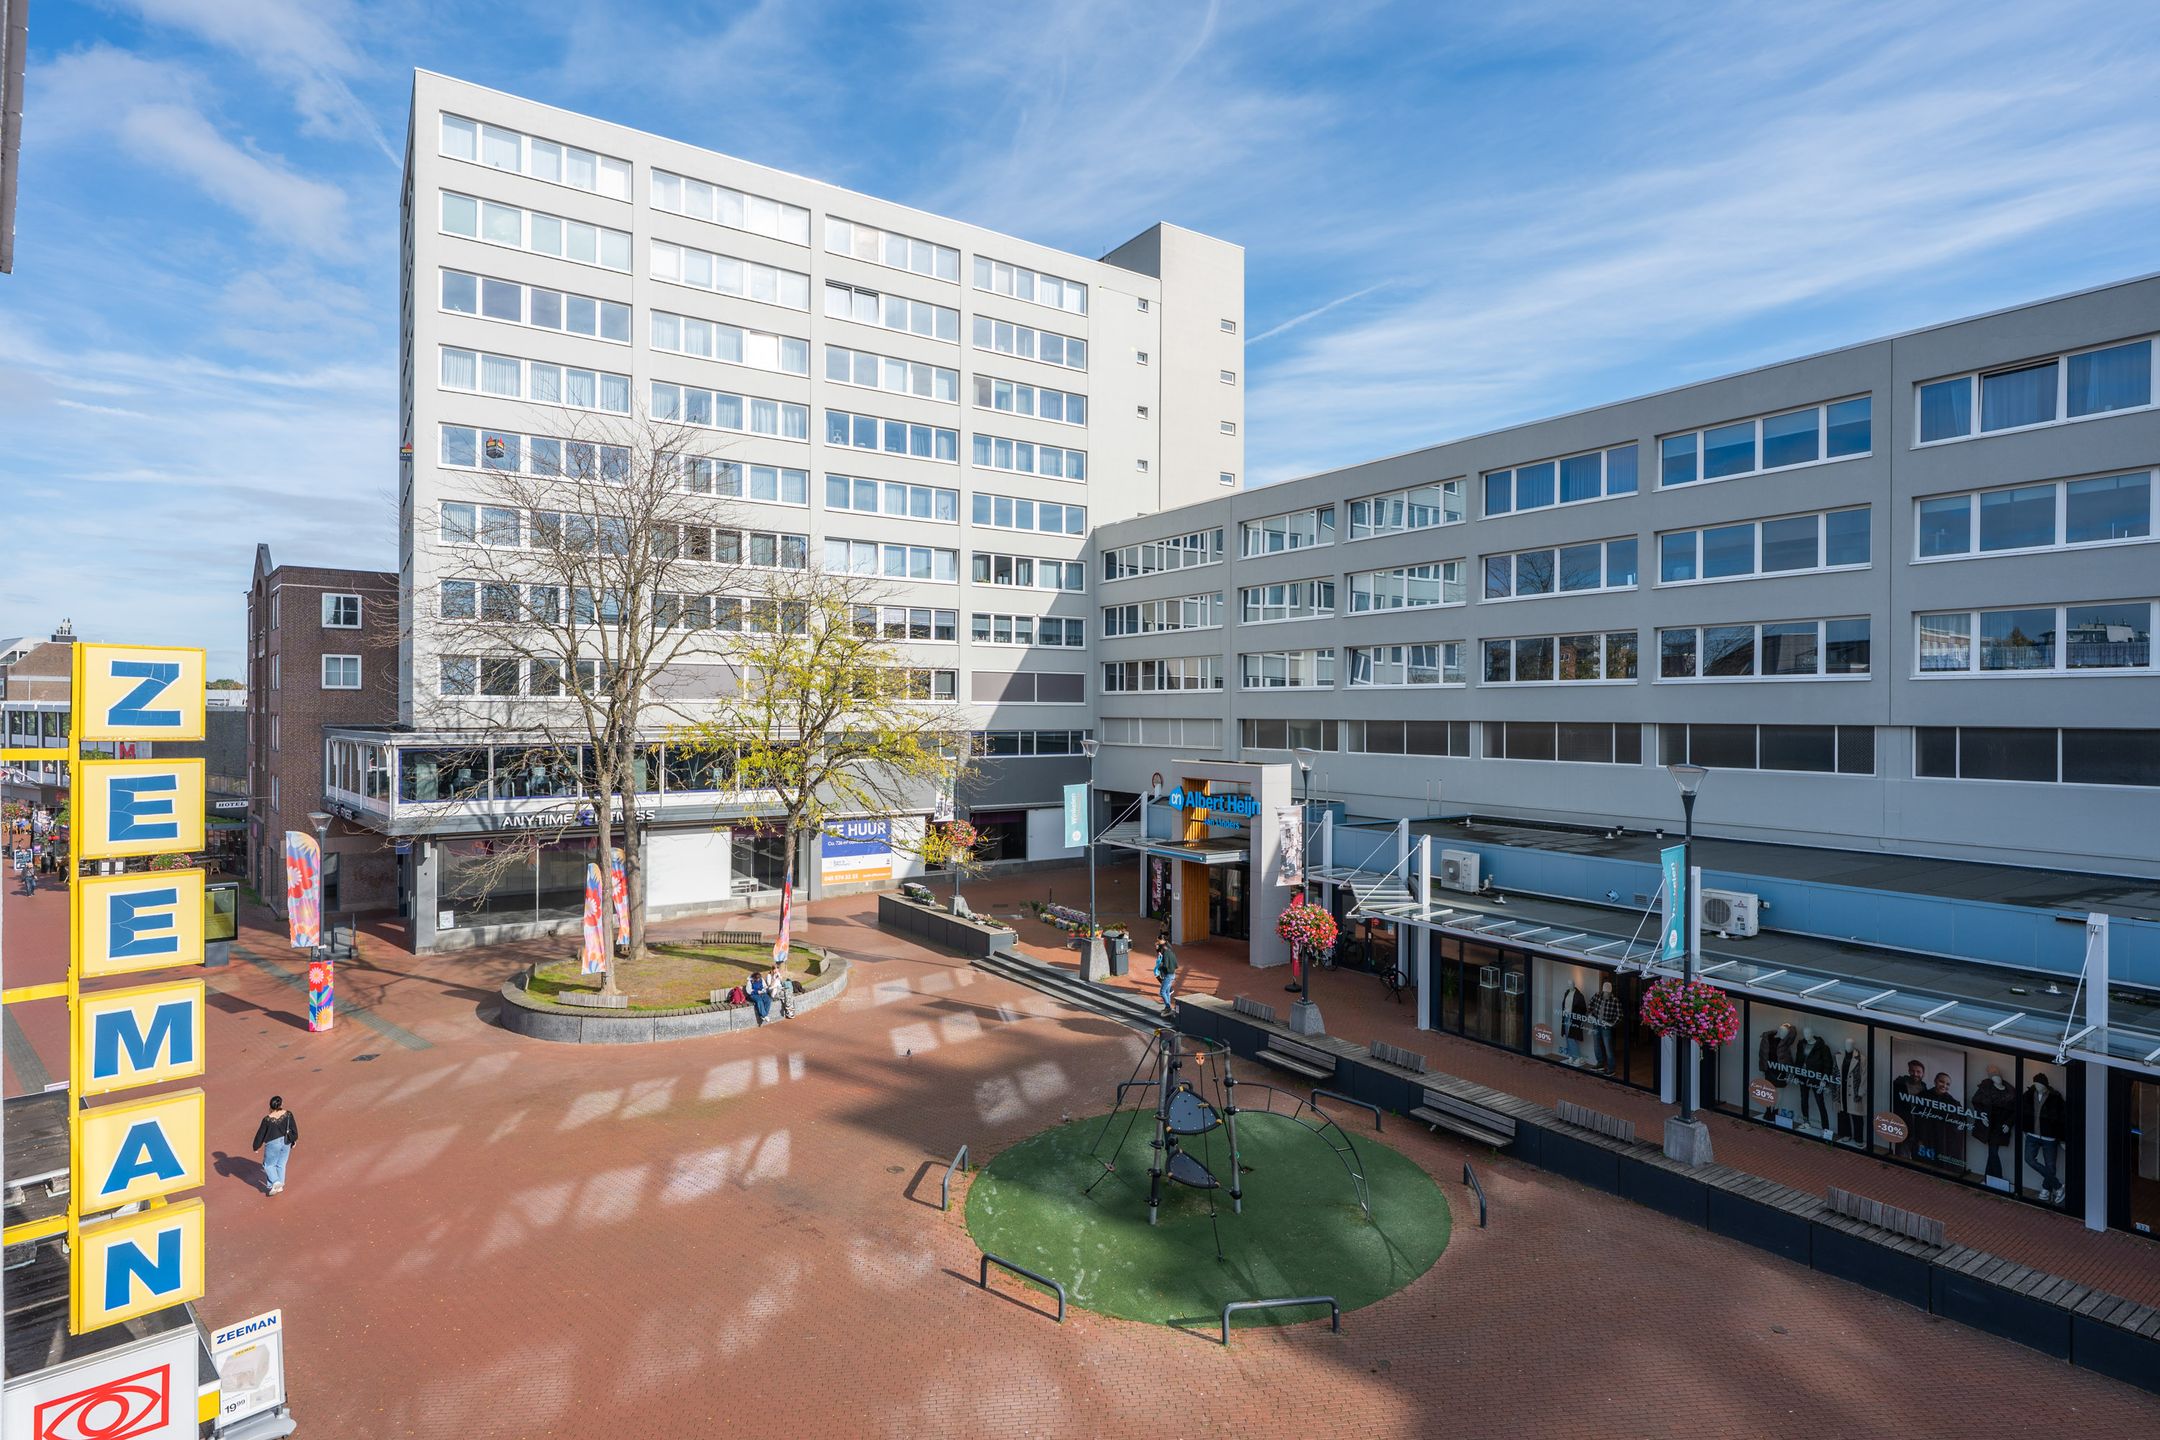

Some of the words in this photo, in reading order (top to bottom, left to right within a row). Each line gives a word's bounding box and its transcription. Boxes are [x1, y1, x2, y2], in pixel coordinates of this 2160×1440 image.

[1185, 791, 1225, 810] Albert
[1227, 795, 1261, 817] Heijn
[503, 813, 572, 827] ANYTIME
[1216, 818, 1240, 831] Linders
[848, 822, 887, 836] HUUR
[93, 660, 194, 1311] ZEEMAN
[1535, 1031, 1552, 1041] -30%
[1767, 1060, 1841, 1085] WINTERDEALS
[1752, 1089, 1774, 1101] -30%
[1899, 1092, 1989, 1121] WINTERDEALS
[1878, 1123, 1904, 1136] -30%
[216, 1315, 277, 1345] ZEEMAN
